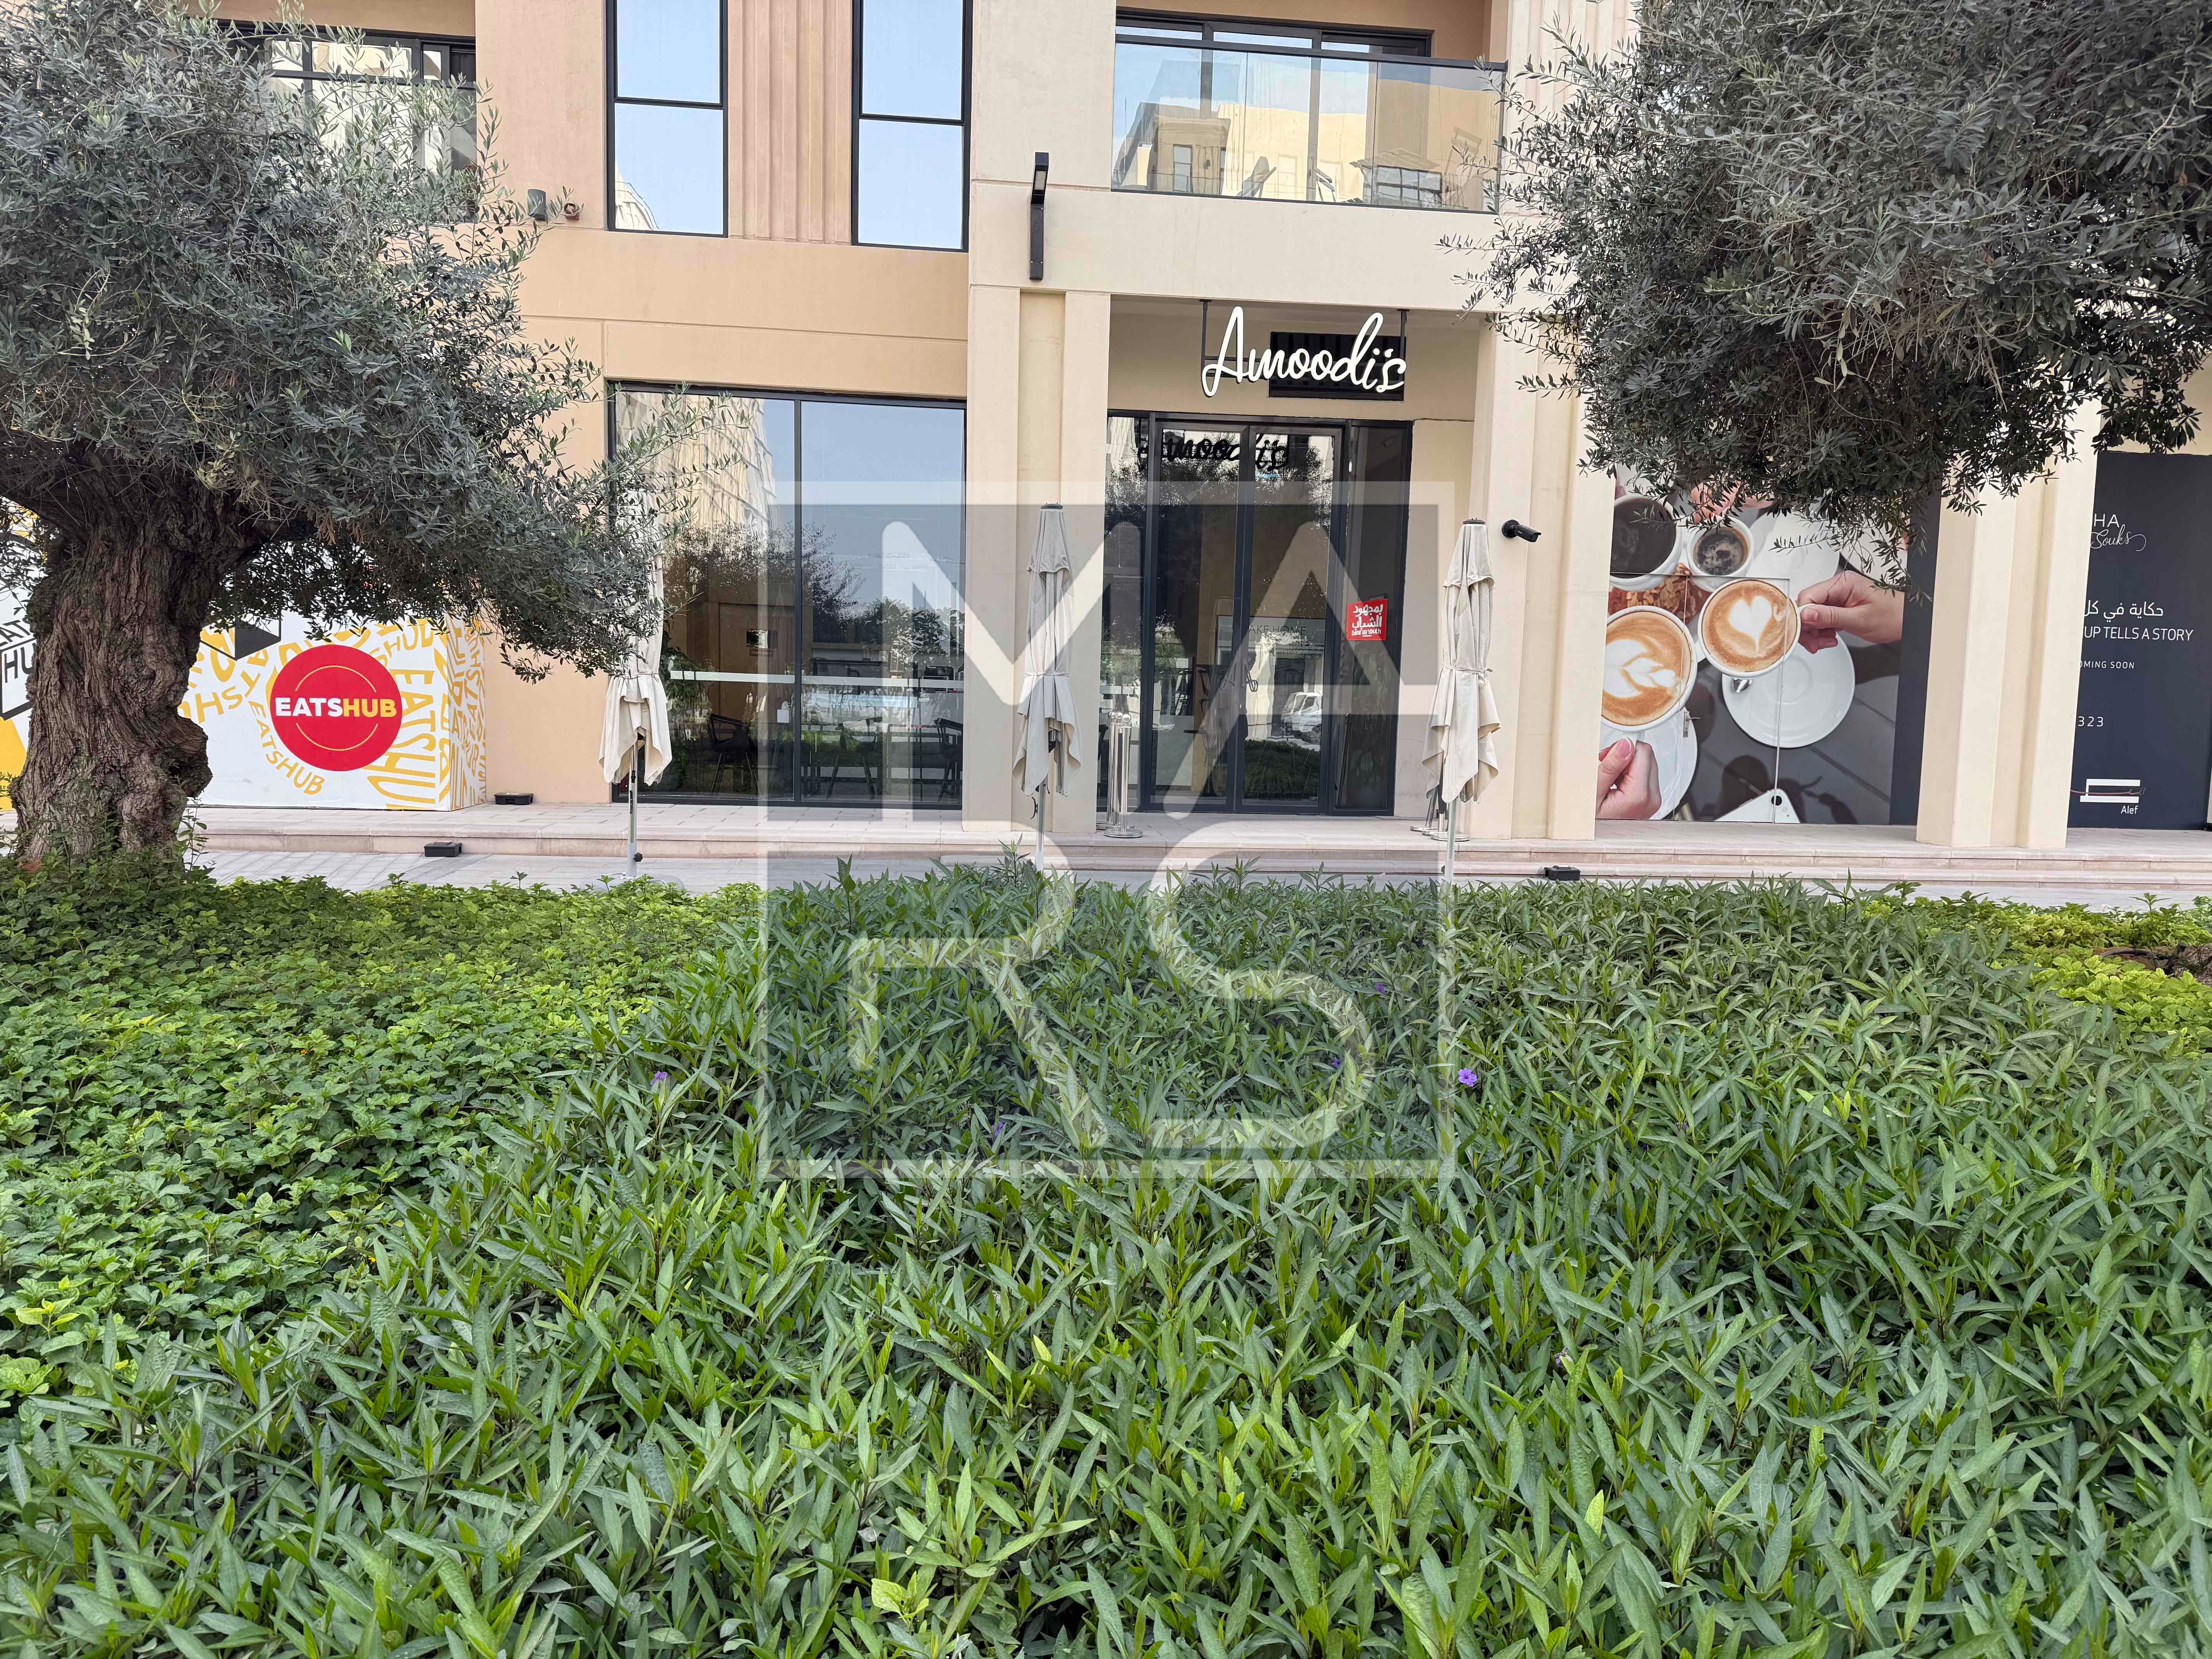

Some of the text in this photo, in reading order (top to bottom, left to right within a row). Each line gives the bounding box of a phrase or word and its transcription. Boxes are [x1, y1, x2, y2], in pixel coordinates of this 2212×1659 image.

[2094, 513, 2120, 528] HA
[2090, 524, 2147, 552] Souks
[1353, 604, 1384, 617] بمجهود
[2084, 599, 2164, 623] حكاية في كل
[1249, 625, 1269, 634] AKE
[1352, 615, 1382, 630] الشباب
[2084, 626, 2194, 641] UP TELLS A STORY
[4, 642, 36, 684] HU
[2111, 661, 2135, 669] SOON
[275, 697, 397, 718] EATSHUB
[2078, 716, 2104, 727] 323
[248, 700, 326, 796] EATSHUB
[2121, 805, 2139, 814] Alef
